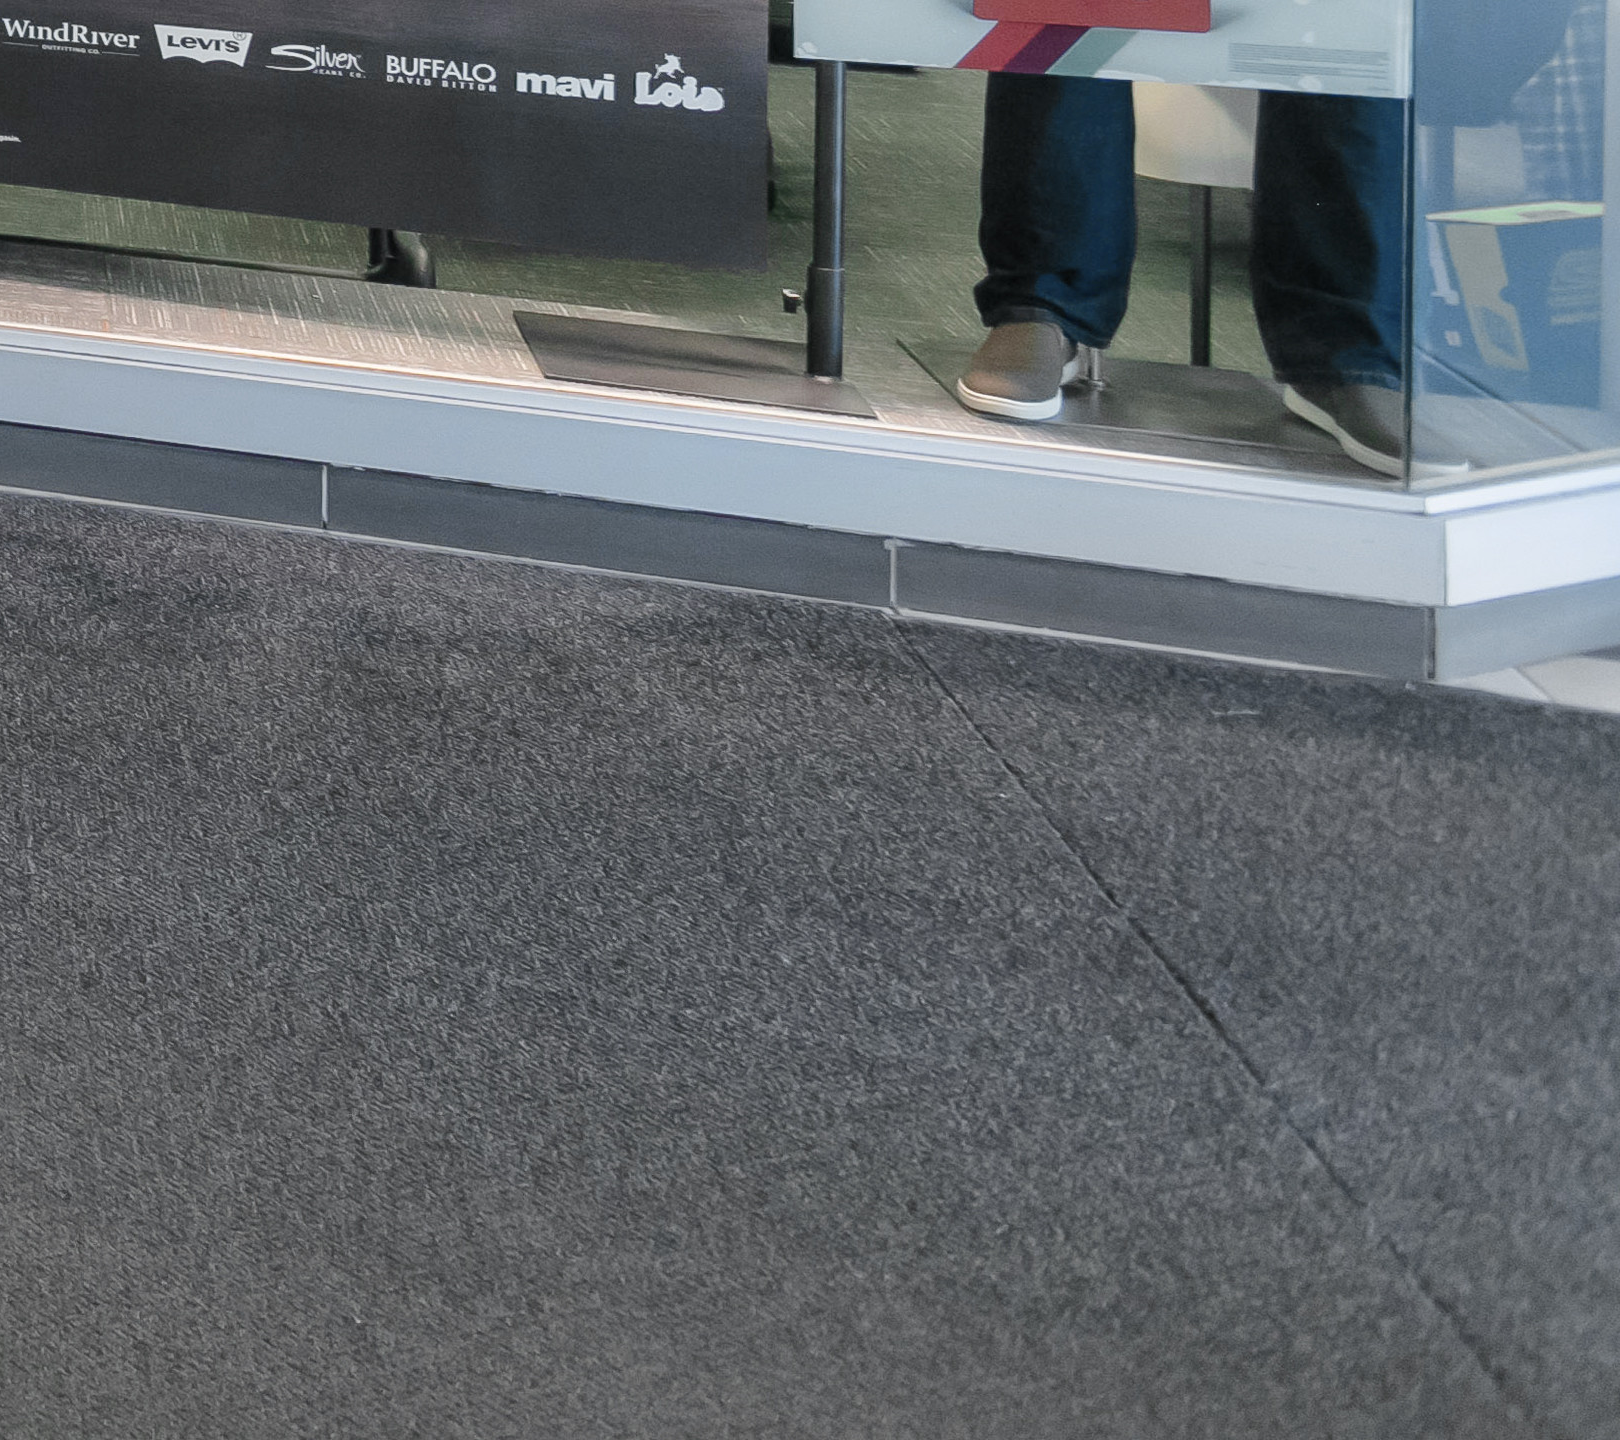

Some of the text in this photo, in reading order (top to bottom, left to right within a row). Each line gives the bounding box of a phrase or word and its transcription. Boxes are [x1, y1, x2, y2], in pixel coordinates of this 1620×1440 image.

[1, 18, 139, 50] WindRiver
[386, 54, 496, 83] BUFFALO
[515, 71, 615, 101] mavi
[386, 75, 498, 93] DAVID BITTON
